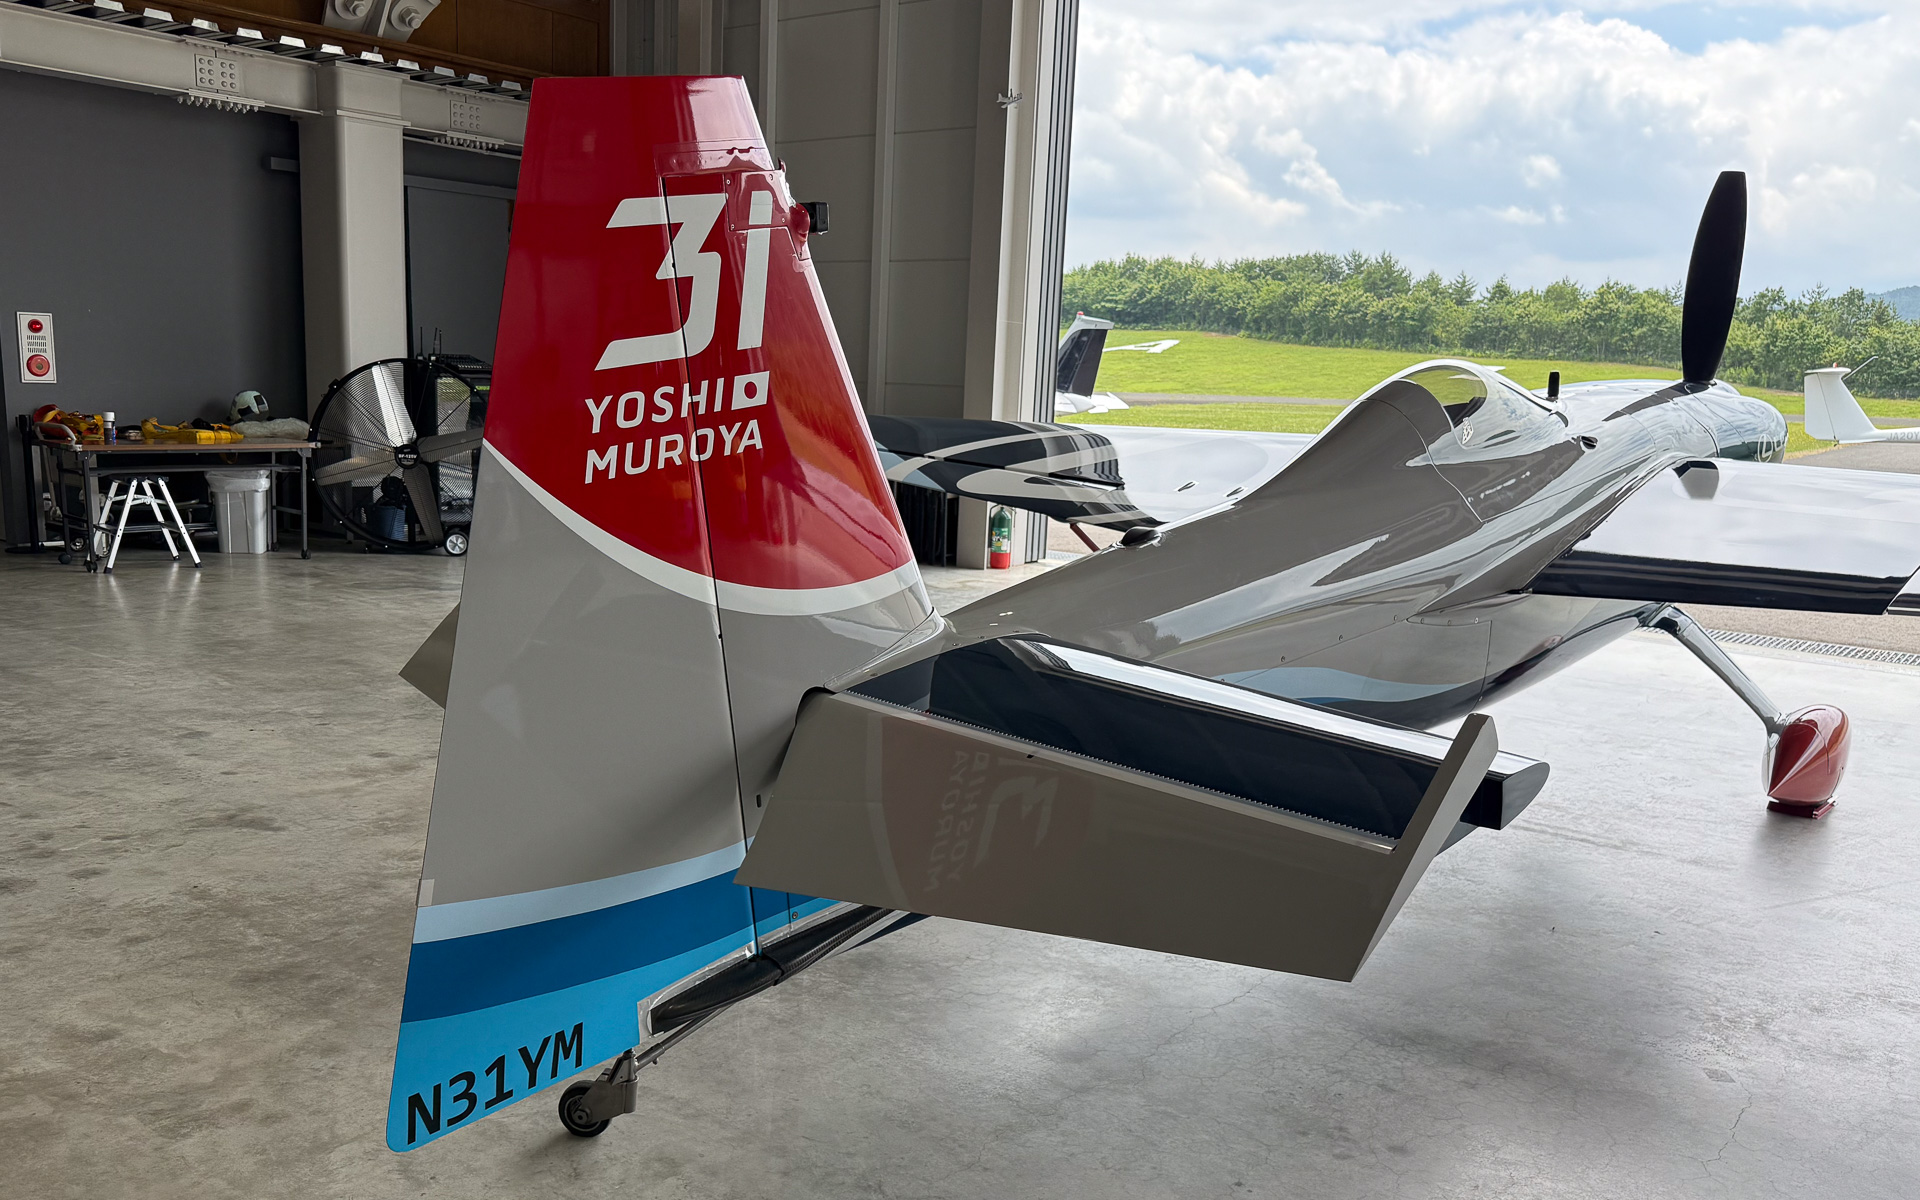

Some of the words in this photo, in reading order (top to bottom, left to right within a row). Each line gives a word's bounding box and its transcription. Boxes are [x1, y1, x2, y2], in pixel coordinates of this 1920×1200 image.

[594, 190, 773, 371] 31
[584, 377, 725, 435] YOSHI
[584, 419, 764, 485] MUROYA
[407, 1021, 584, 1146] N31YM
